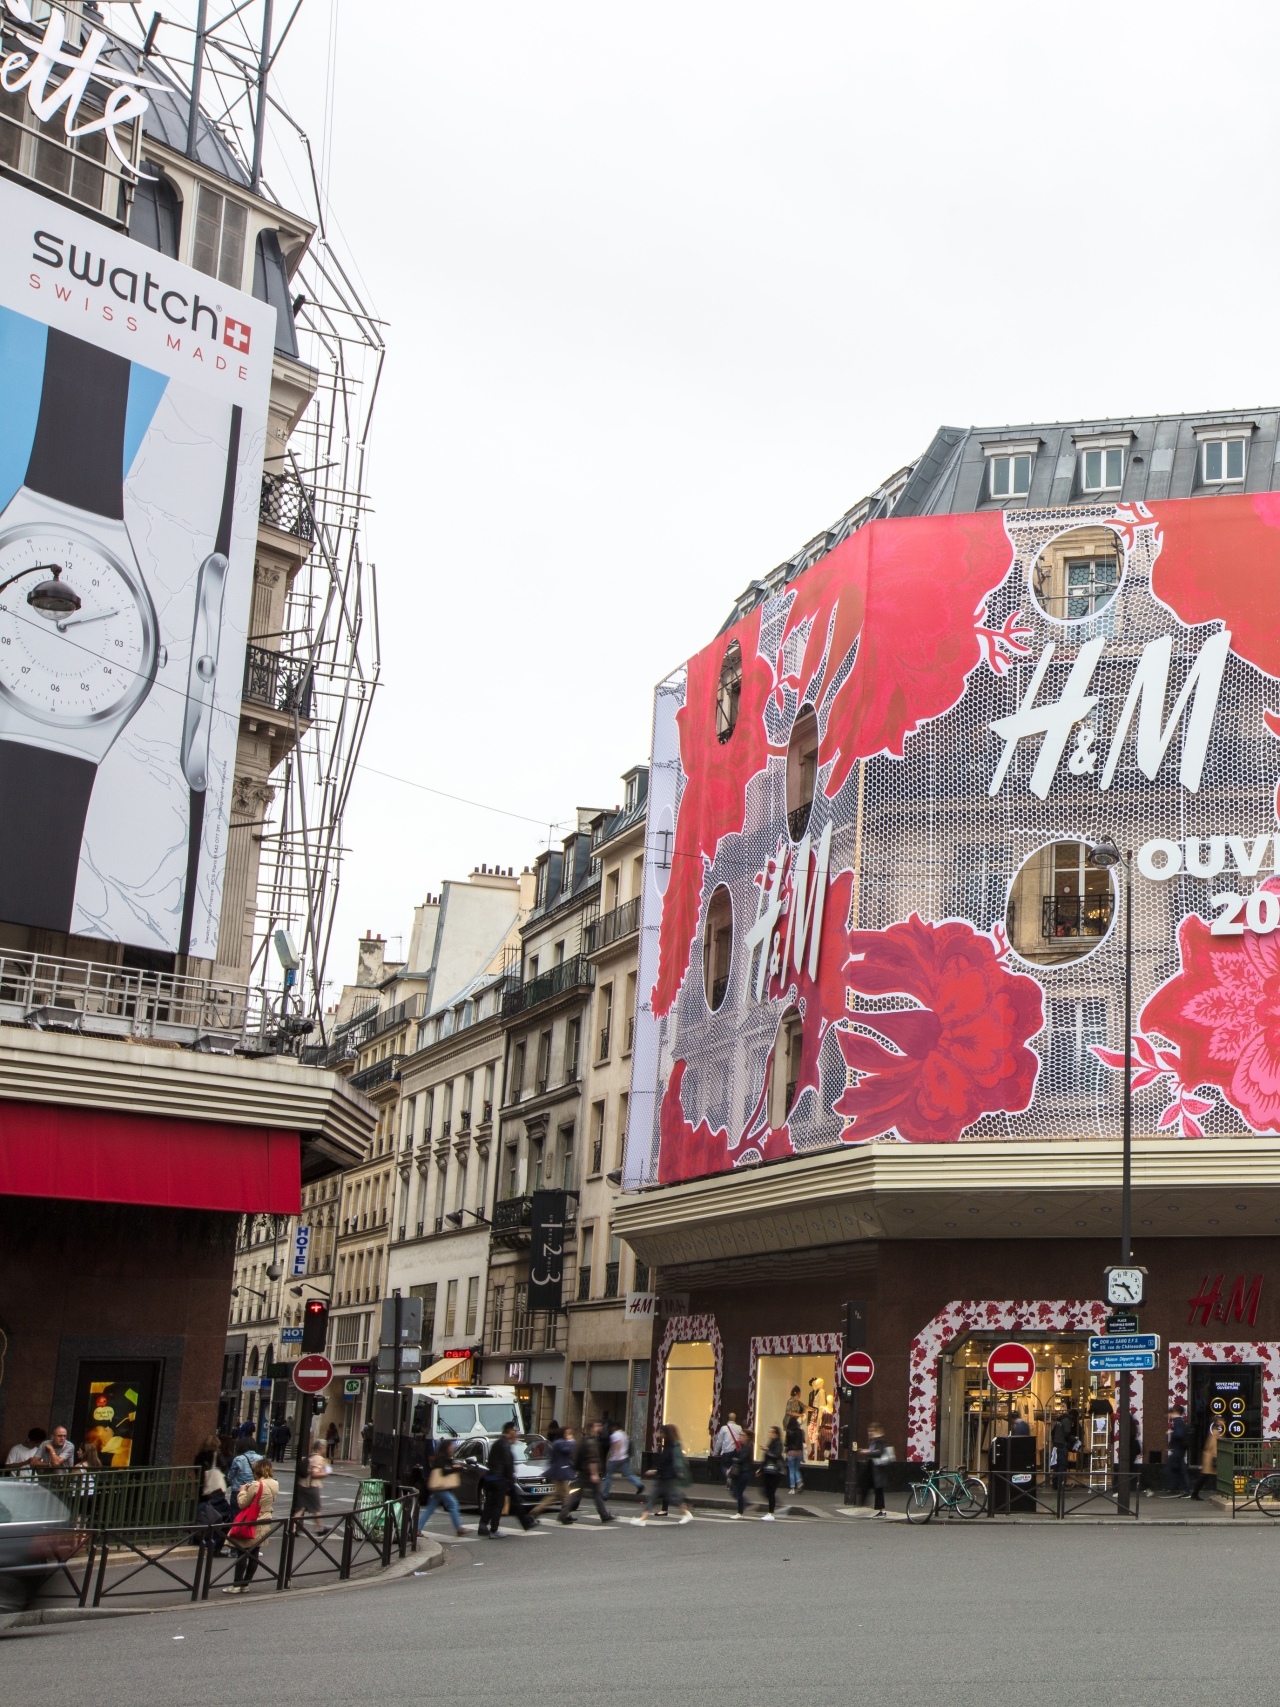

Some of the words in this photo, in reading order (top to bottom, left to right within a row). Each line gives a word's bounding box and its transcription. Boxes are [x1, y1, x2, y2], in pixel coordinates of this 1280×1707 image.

[29, 273, 138, 332] SWISS
[166, 333, 248, 381] MADE
[65, 560, 72, 569] 12
[92, 579, 100, 587] 01
[1, 636, 11, 645] 08
[50, 684, 60, 692] 06
[80, 683, 90, 691] 05
[989, 630, 1231, 800] H&M
[743, 819, 833, 1003] H&M
[1210, 891, 1280, 935] 20
[294, 1227, 308, 1274] HOTEL
[629, 1298, 652, 1314] H&M
[1188, 1274, 1264, 1327] H&M
